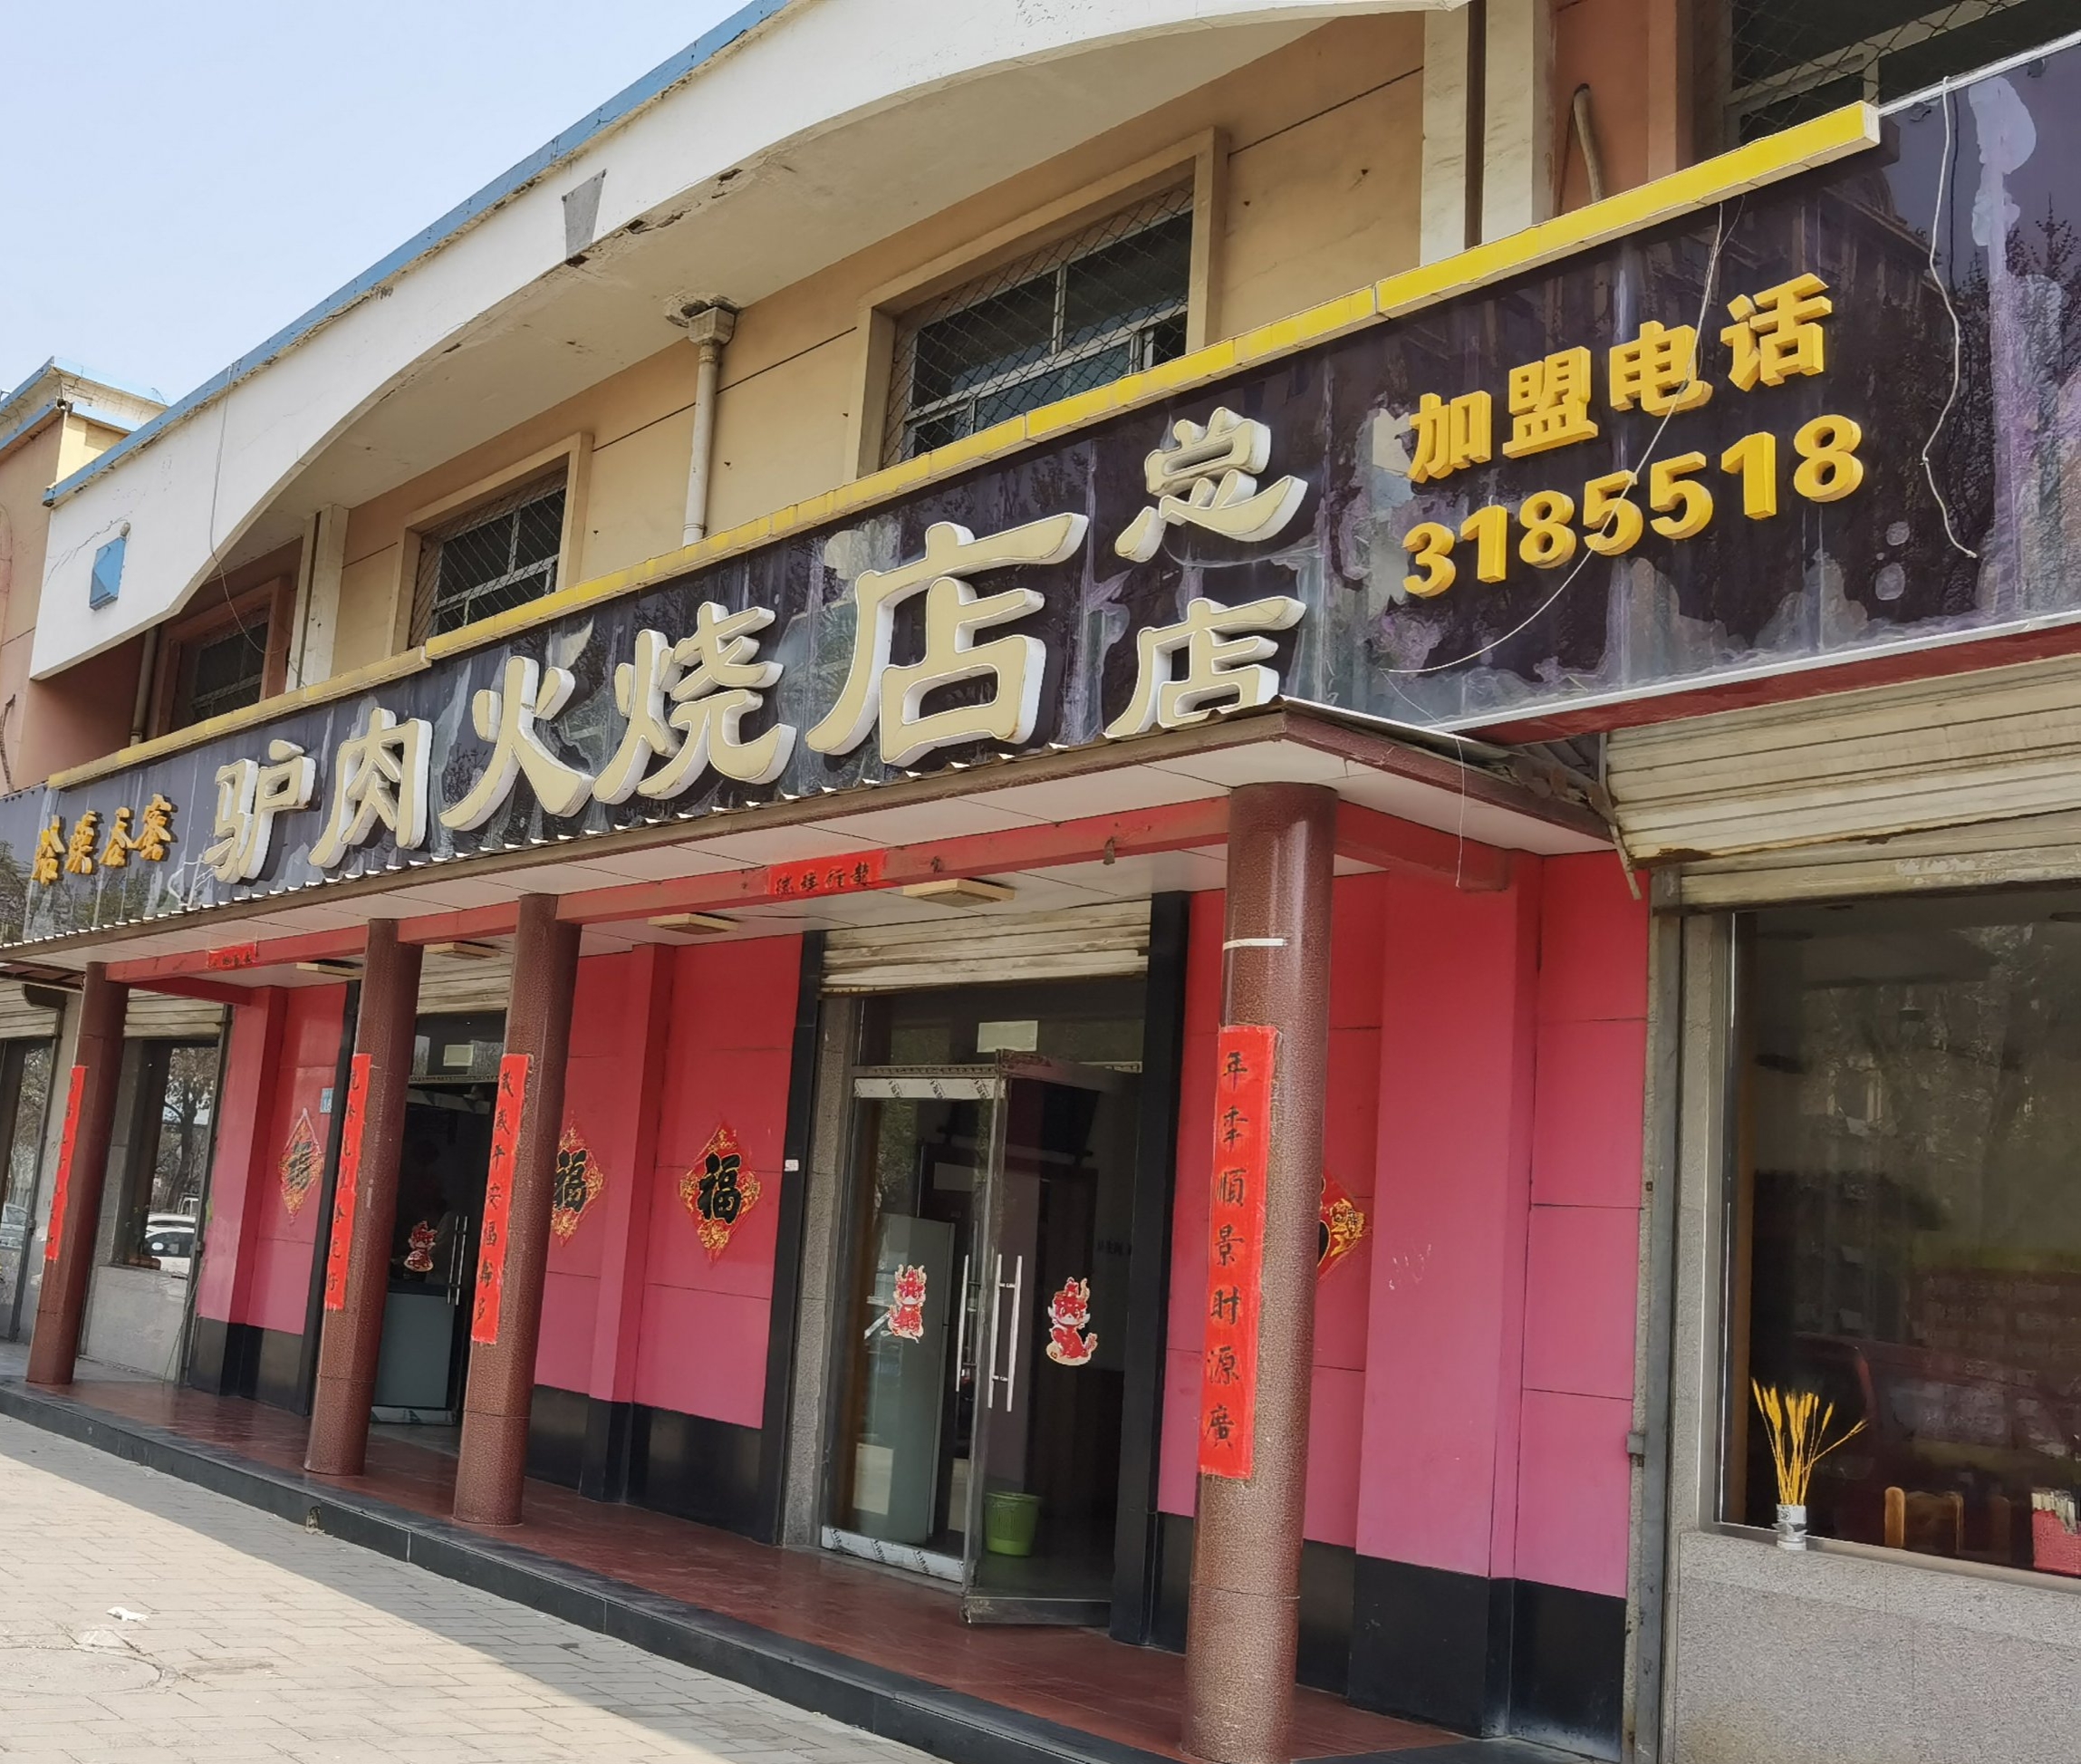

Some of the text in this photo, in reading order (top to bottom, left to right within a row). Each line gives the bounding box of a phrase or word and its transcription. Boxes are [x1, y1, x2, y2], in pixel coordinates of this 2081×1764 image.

[1408, 274, 1832, 483] 加盟电话
[1103, 405, 1309, 740] 总店
[1402, 414, 1864, 599] 3185518
[204, 512, 1087, 883] 驴肉火烧店
[697, 1152, 742, 1225] 福
